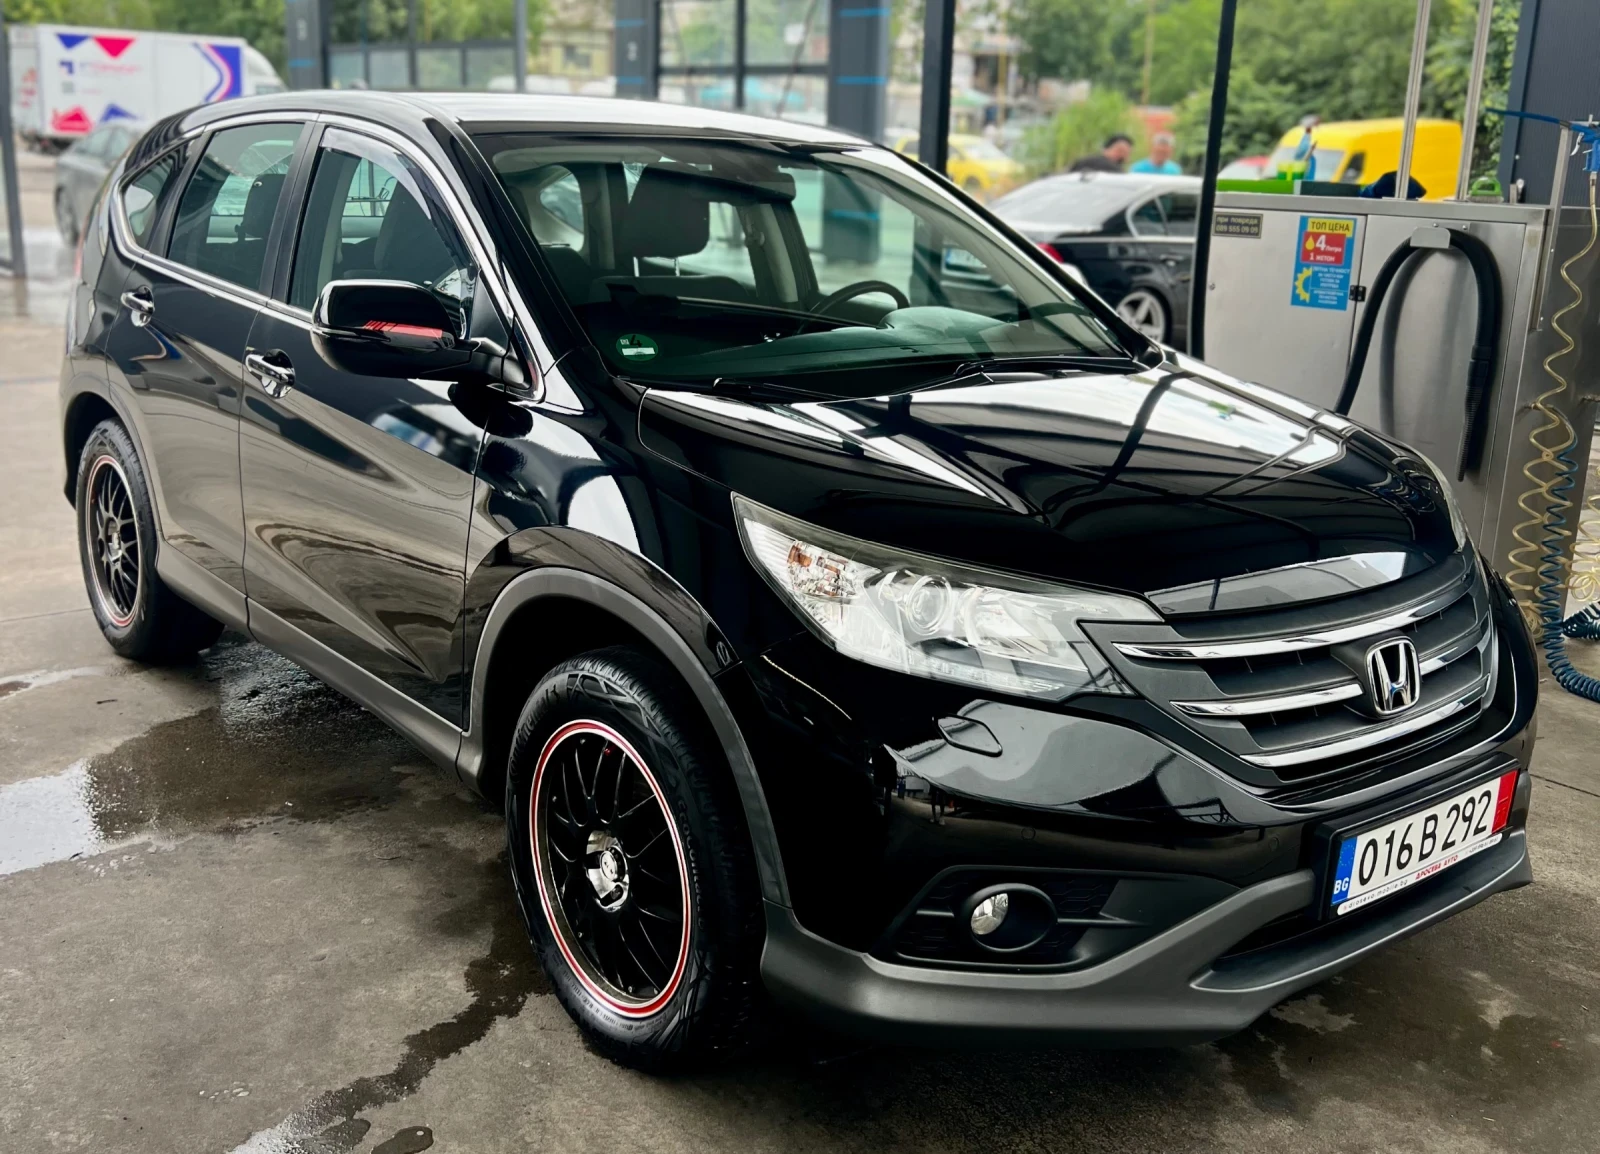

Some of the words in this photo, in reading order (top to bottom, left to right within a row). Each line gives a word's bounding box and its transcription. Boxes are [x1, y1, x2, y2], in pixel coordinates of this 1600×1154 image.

[1311, 221, 1327, 230] ТОП
[1328, 222, 1350, 232] ЦЕНА
[1315, 234, 1327, 251] 4
[1309, 253, 1315, 261] 1
[630, 335, 642, 347] 4
[1333, 877, 1350, 895] BG
